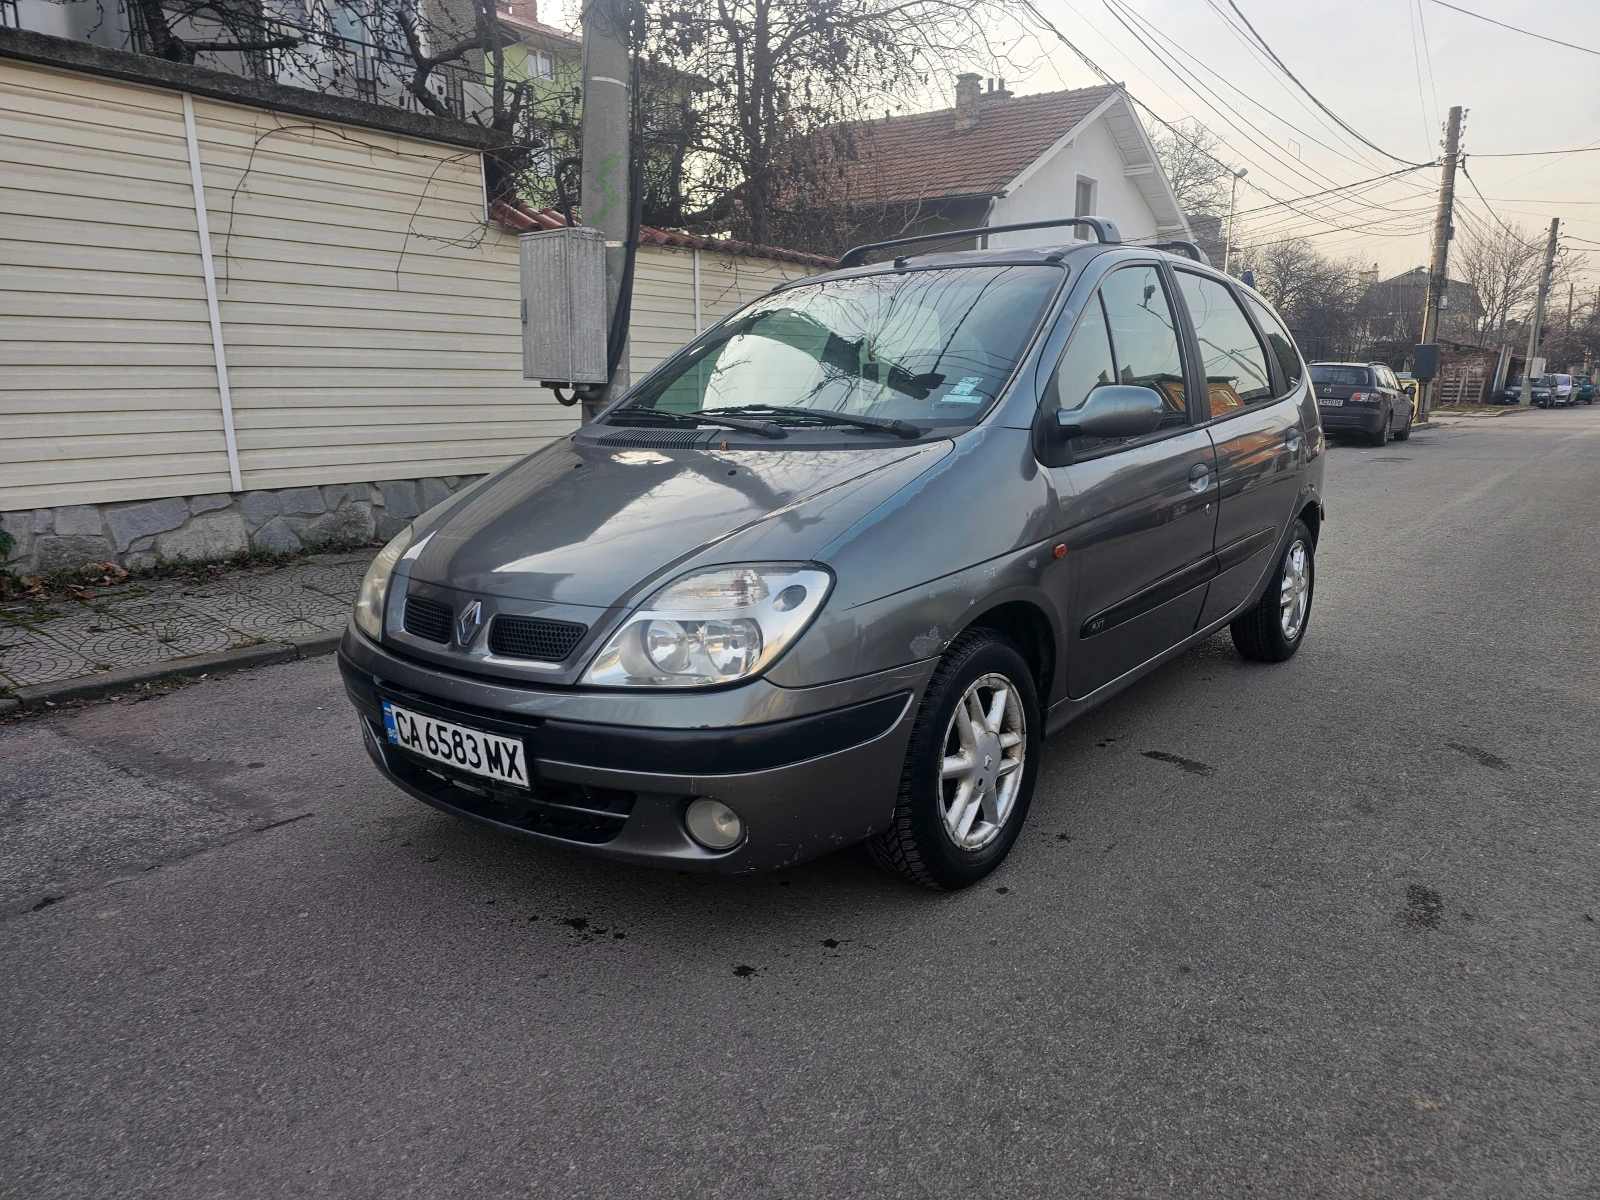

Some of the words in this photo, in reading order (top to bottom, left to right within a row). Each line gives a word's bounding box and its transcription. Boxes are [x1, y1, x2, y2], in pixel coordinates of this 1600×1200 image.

[395, 711, 424, 751] CA
[425, 721, 482, 769] 6583
[483, 737, 523, 781] MX
